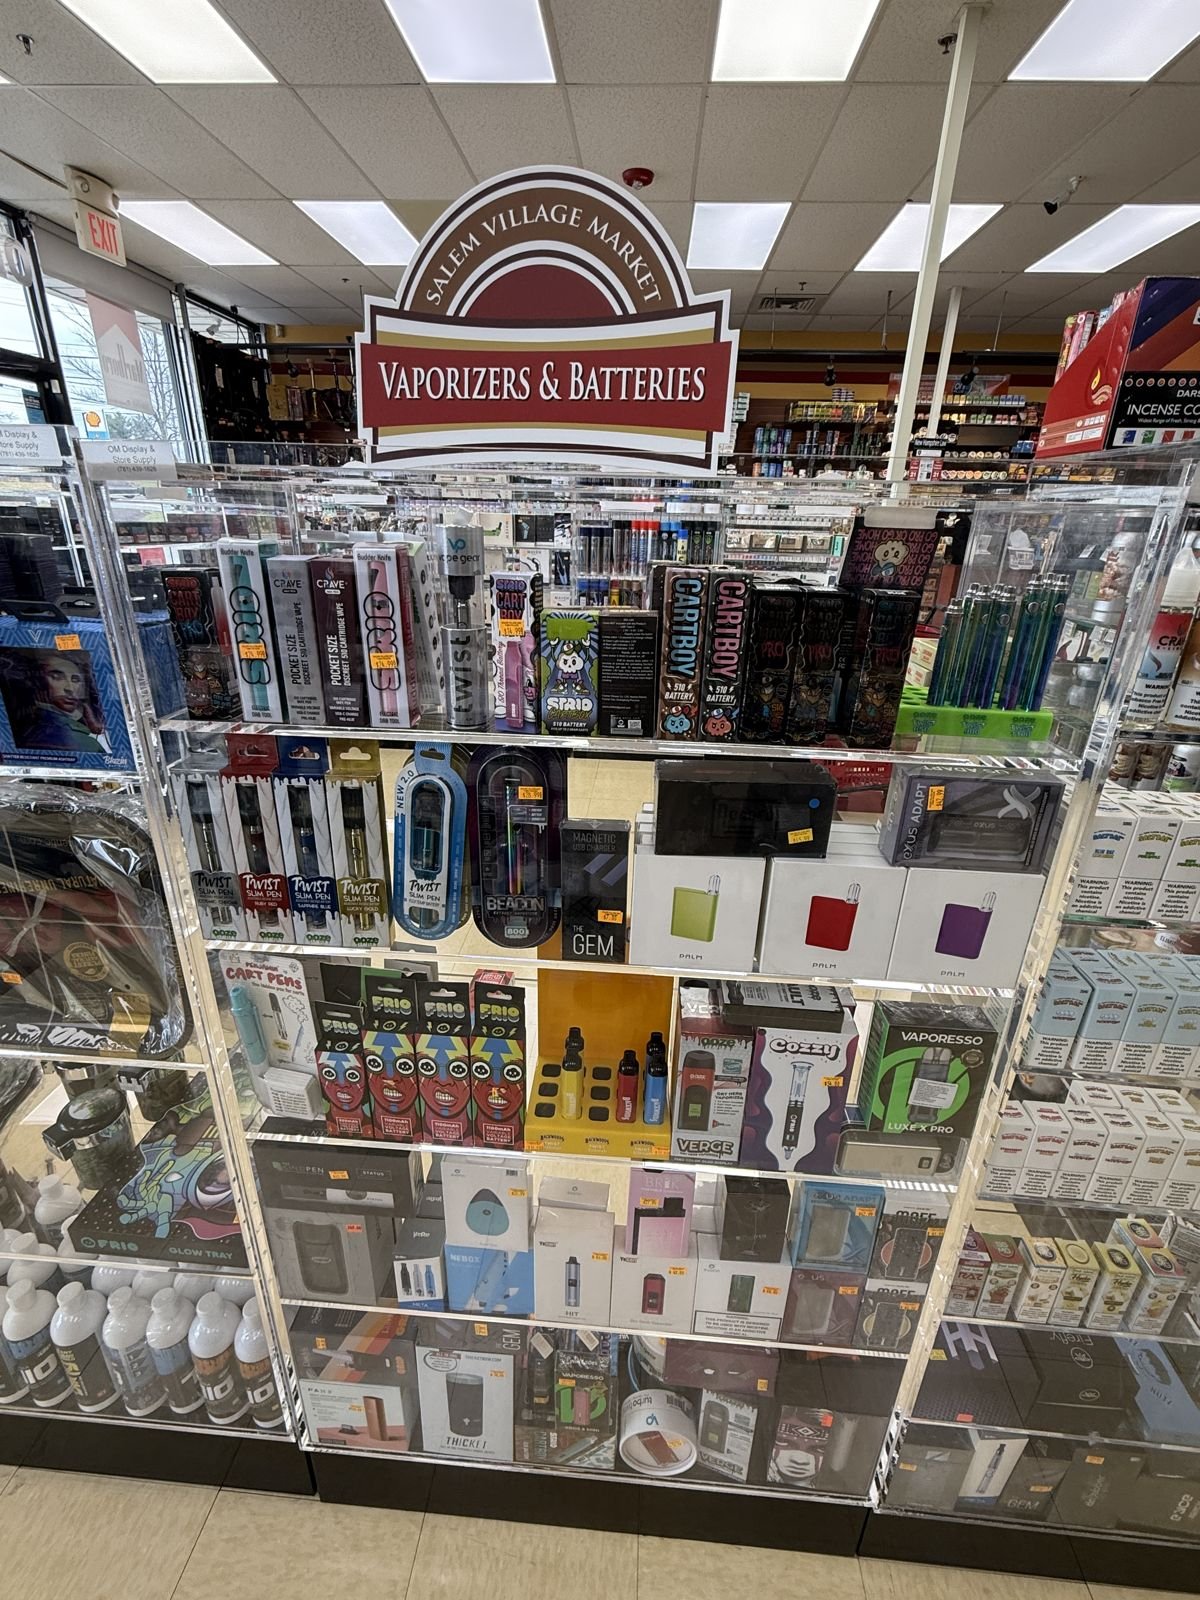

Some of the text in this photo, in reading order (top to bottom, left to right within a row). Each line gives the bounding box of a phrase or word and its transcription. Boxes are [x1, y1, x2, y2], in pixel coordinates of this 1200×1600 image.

[88, 211, 119, 257] EXIT
[425, 204, 662, 306] SALEM VILLAGE MARKET
[378, 361, 706, 401] VAPORIZERS & BATTERIES
[1127, 404, 1181, 415] INCENSE
[7, 431, 30, 439] Display
[17, 442, 38, 450] Supply
[123, 446, 148, 454] Display
[132, 457, 156, 465] Supply
[221, 548, 240, 556] Budder
[357, 553, 391, 562] Budder Knife
[460, 554, 480, 564] gear
[274, 579, 302, 588] CRAVE
[317, 580, 345, 589] CRAVE
[496, 592, 526, 608] CART
[670, 577, 701, 676] CARTBOY
[712, 580, 746, 679] CARTBOY
[294, 602, 311, 685] DISCREET CARTRIDGE VAPE
[336, 602, 351, 686] DISCREET CARTRIDGE VAPE
[286, 634, 301, 684] POCKET SIZE
[327, 635, 341, 686] POCKET SIZE
[497, 642, 506, 665] Battery
[451, 635, 473, 713] twist
[497, 666, 505, 688] Thread
[674, 683, 685, 691] 510
[716, 685, 727, 693] 510
[665, 691, 694, 702] BATTERY
[707, 694, 735, 704] BATTERY
[401, 770, 414, 784] 2.0
[910, 783, 927, 824] ADAPT
[573, 833, 616, 844] MAGNETIC
[195, 872, 232, 888] TWIST
[243, 874, 280, 891] TWIST
[292, 877, 330, 893] TWIST
[409, 879, 441, 892] TWIST
[199, 888, 217, 896] SLIM
[341, 881, 379, 895] TWIST
[295, 892, 313, 900] SLIM
[486, 897, 544, 911] BEACON
[573, 934, 613, 956] GEM
[226, 967, 264, 980] CART
[267, 970, 303, 990] PENS
[372, 996, 412, 1016] FRIO
[424, 1002, 466, 1019] FRIO
[479, 1003, 520, 1023] FRIO
[322, 1019, 359, 1035] FRIO
[700, 1037, 736, 1048] ooze
[901, 1031, 983, 1046] VAPORESSO
[769, 1038, 840, 1060] Cozzy
[888, 1122, 954, 1134] LUXE X PRO
[677, 1138, 734, 1154] VERGE
[97, 1239, 138, 1252] FRIO
[169, 1247, 232, 1259] GLOW TRAY
[503, 1329, 521, 1350] GEM
[1051, 1332, 1094, 1346] Firefly
[562, 1372, 604, 1381] VAPORESSO
